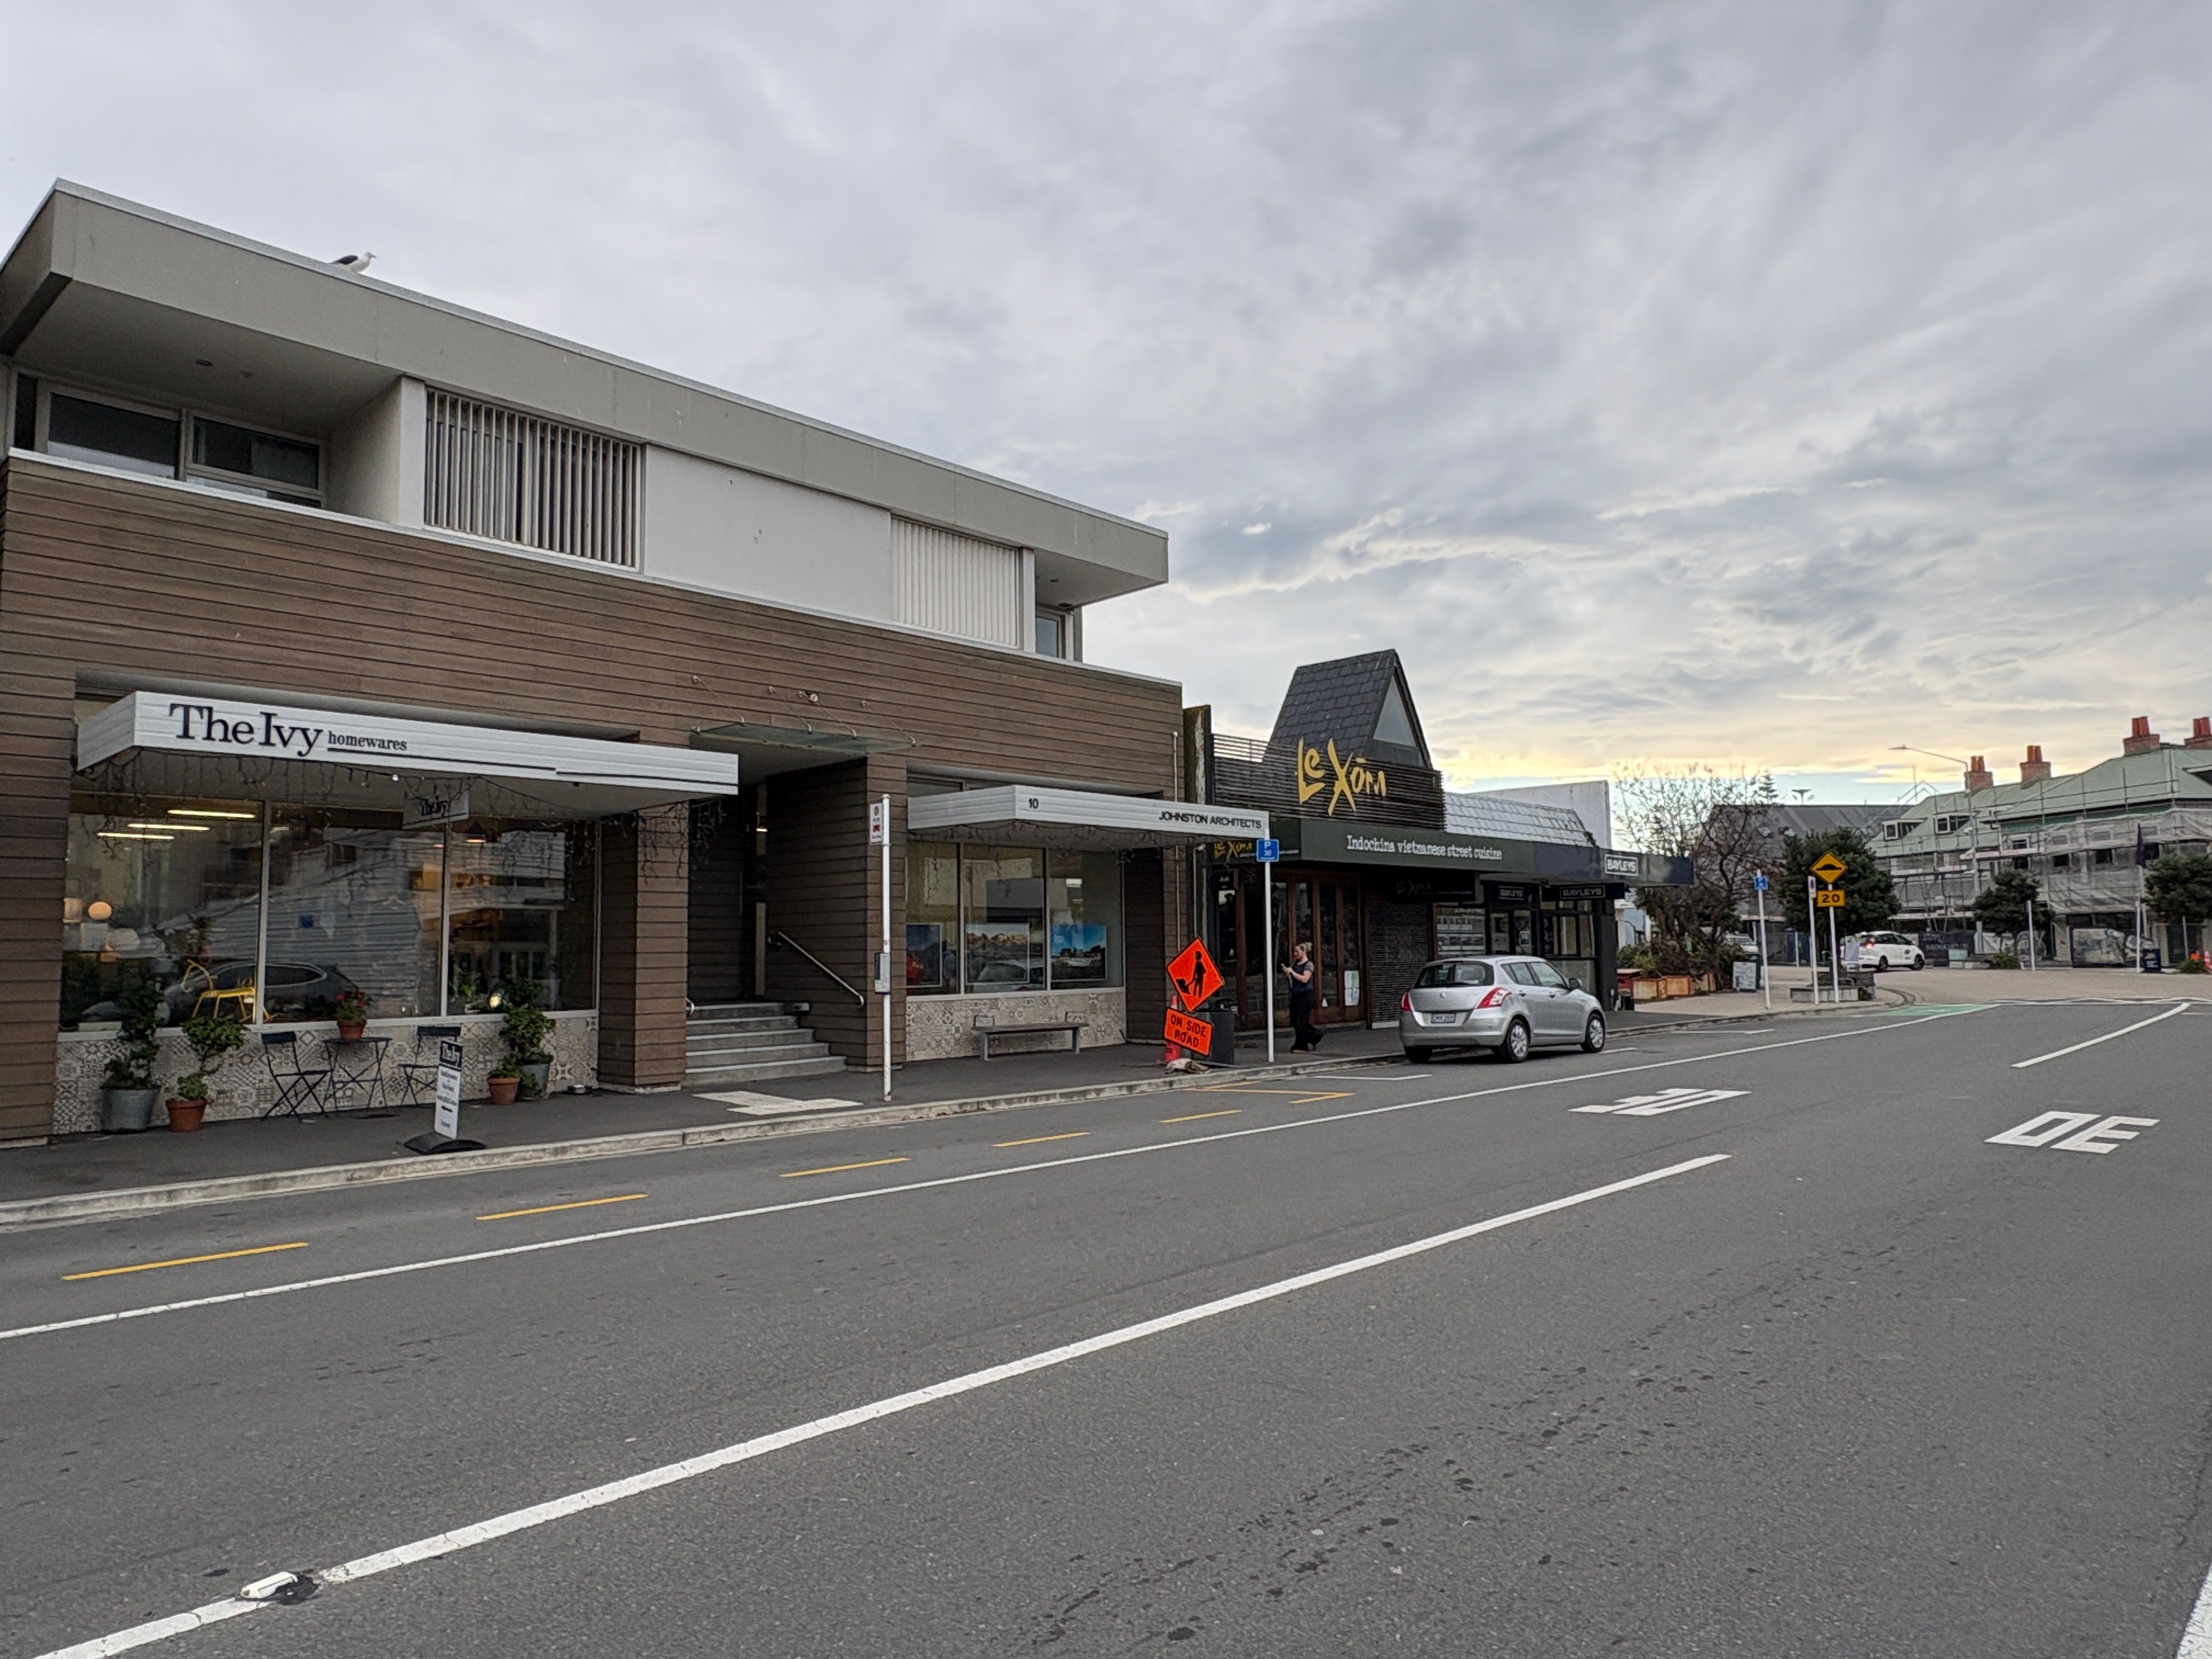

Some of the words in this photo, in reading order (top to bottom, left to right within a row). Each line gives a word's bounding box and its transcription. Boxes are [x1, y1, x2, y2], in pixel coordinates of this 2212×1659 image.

[328, 731, 408, 751] homewares
[1297, 737, 1326, 805] Le
[1028, 798, 1039, 809] 10
[1159, 811, 1207, 824] JOHNSTON
[1210, 816, 1262, 829] ARCHITECTS
[1346, 834, 1396, 853] Indochina
[1397, 839, 1446, 857] vietnamese
[1447, 844, 1473, 857] street
[1474, 846, 1502, 860] cuisine
[1607, 859, 1636, 872] BAYLEYS
[1821, 894, 1840, 904] 20
[1170, 1014, 1183, 1029] ON
[1186, 1019, 1207, 1038] SIDE
[1174, 1029, 1199, 1048] ROAD
